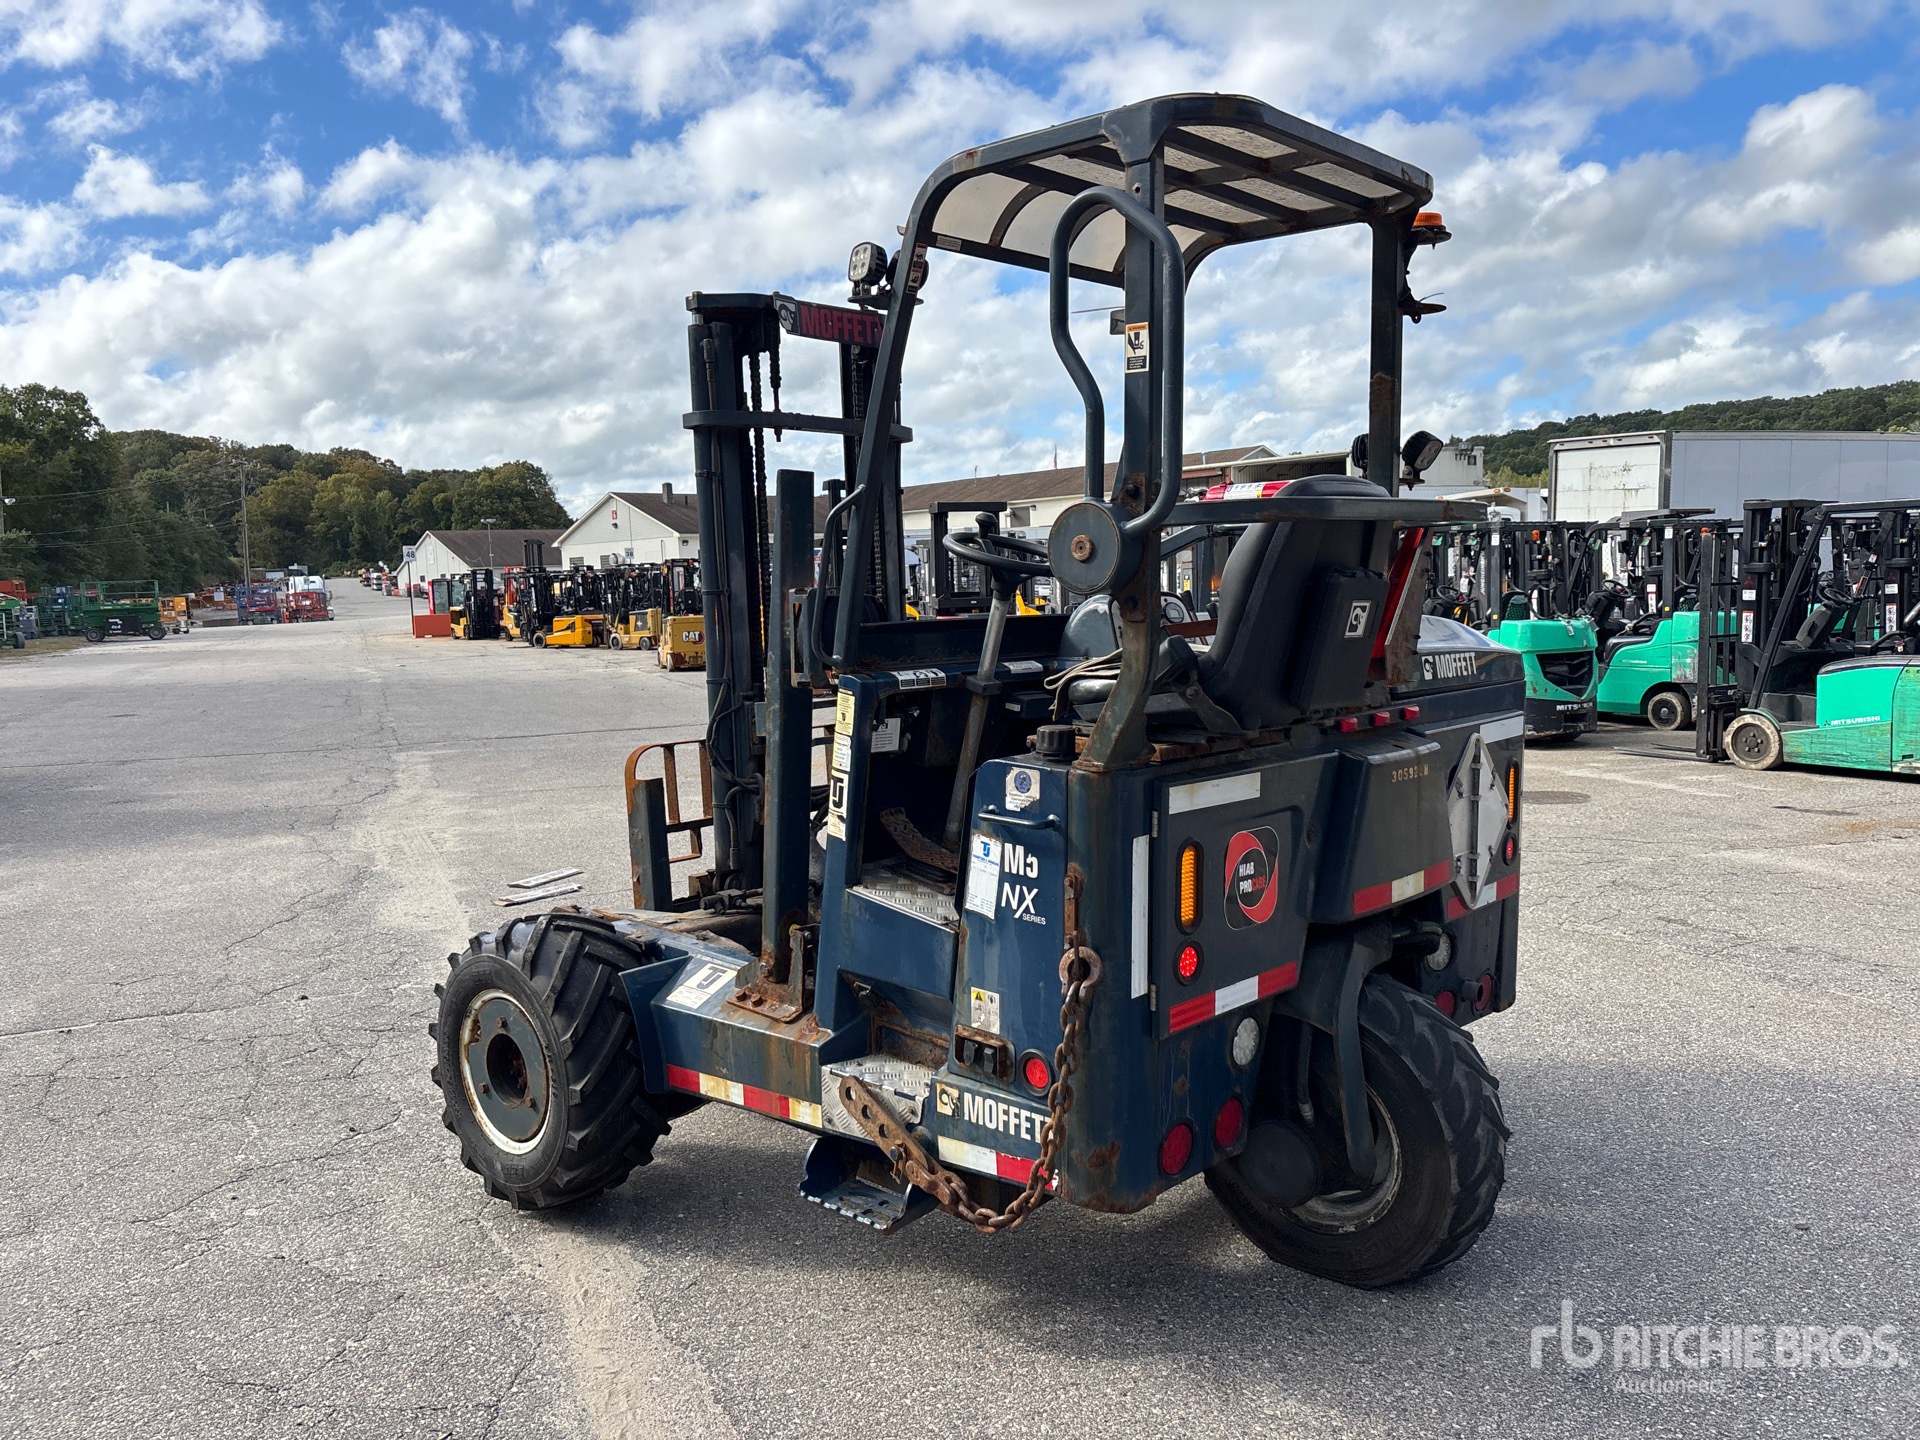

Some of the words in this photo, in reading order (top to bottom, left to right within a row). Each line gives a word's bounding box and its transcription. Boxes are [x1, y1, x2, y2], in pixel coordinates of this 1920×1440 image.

[405, 550, 416, 558] 48
[682, 631, 700, 642] CAT
[1435, 652, 1477, 679] MOFFETT
[1830, 715, 1881, 726] MITSUBISHI
[1239, 861, 1255, 877] HIAB
[1001, 881, 1039, 918] NX
[1022, 913, 1047, 925] SERIES
